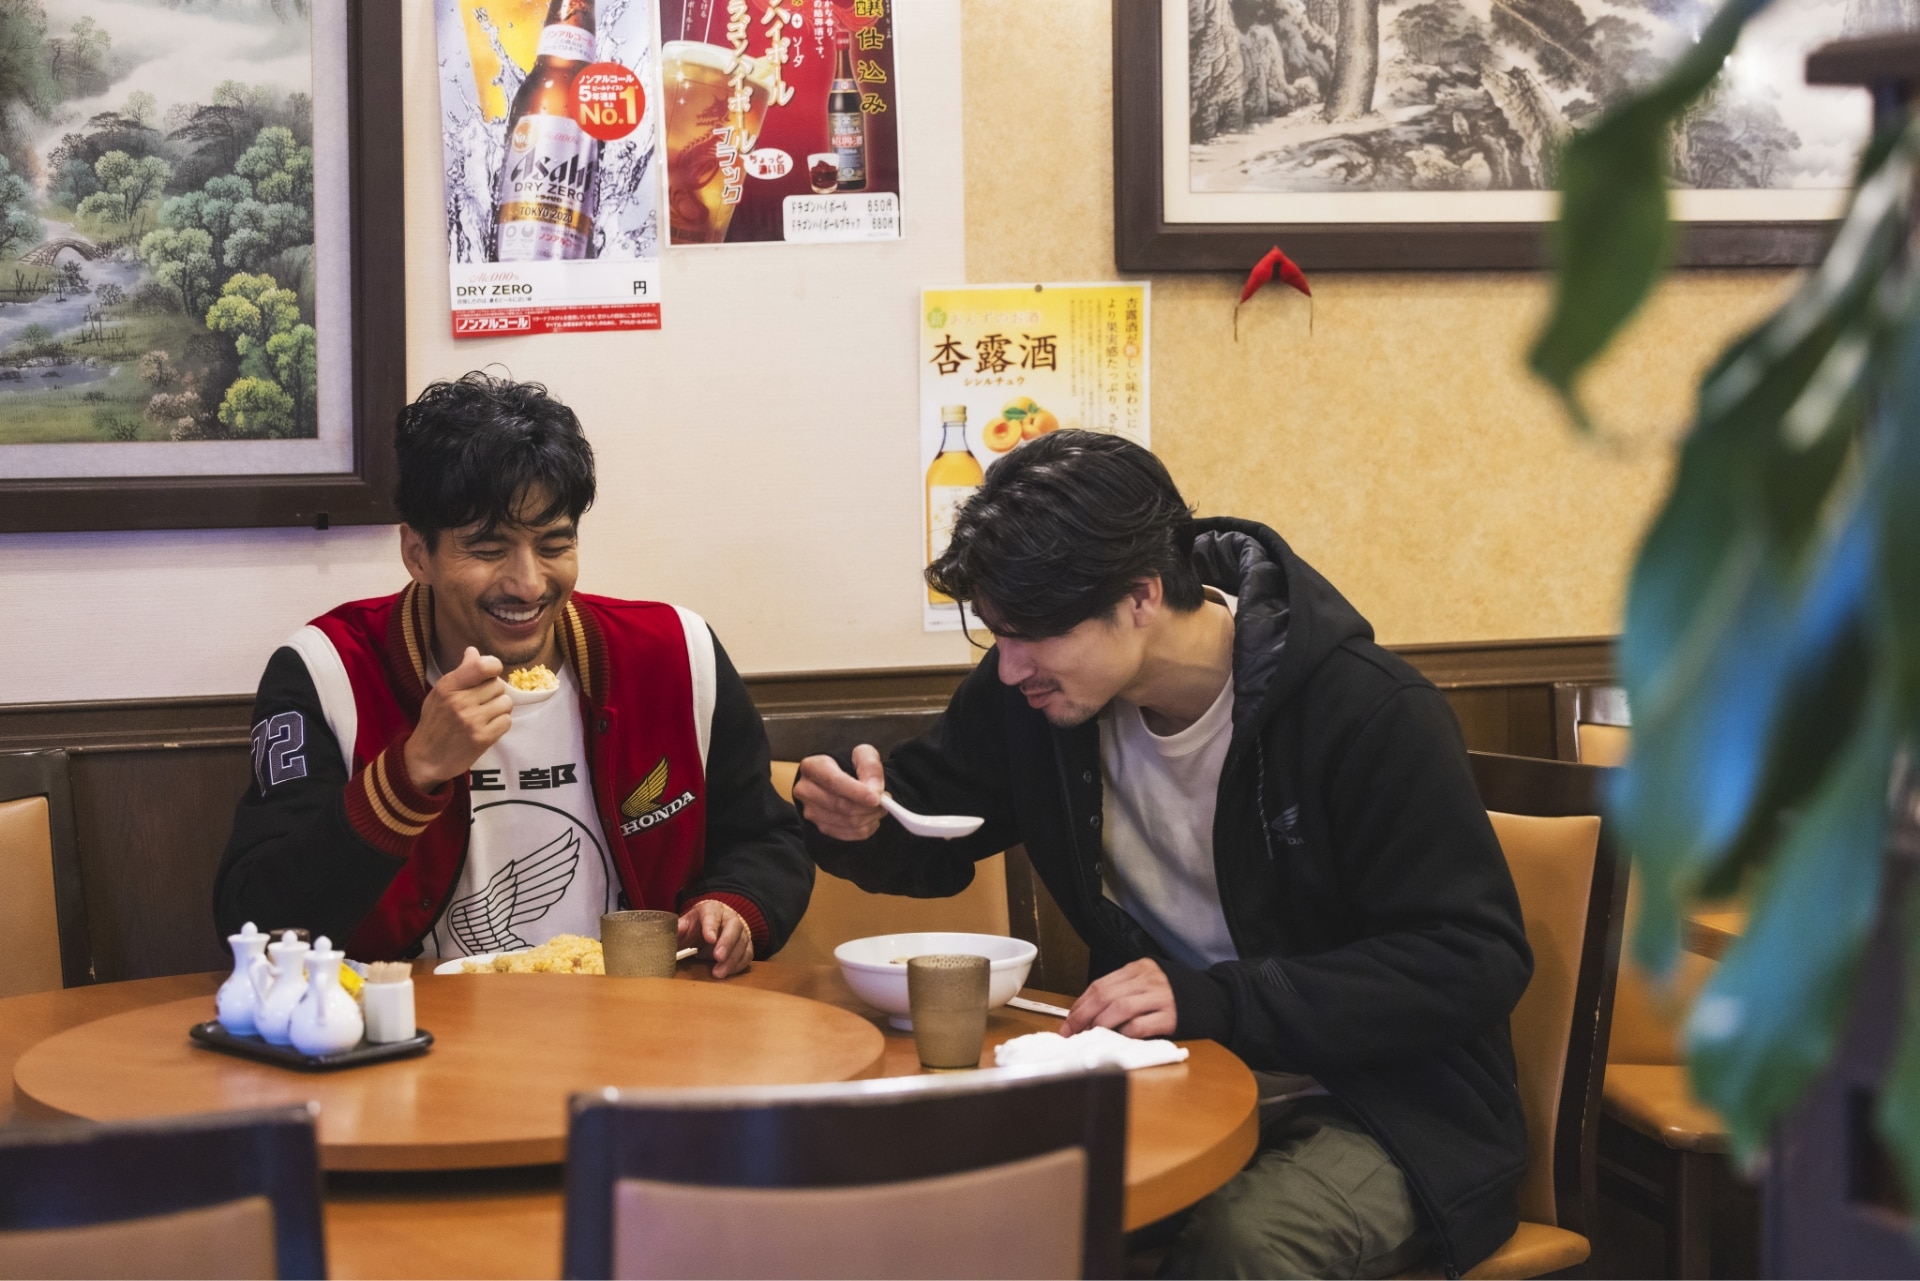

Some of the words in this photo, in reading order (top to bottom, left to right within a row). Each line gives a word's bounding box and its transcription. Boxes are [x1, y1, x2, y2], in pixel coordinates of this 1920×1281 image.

[792, 36, 805, 68] ソーダ
[579, 74, 634, 84] ノンアルコール
[579, 86, 638, 126] No.1
[750, 154, 785, 164] ちょっと
[510, 152, 594, 193] Asahi
[758, 164, 786, 175] 濃い目
[514, 181, 543, 193] DRY
[547, 183, 585, 204] ZERO
[520, 206, 549, 218] TOKYO
[551, 210, 573, 224] 2020
[456, 285, 488, 297] DRY
[492, 284, 533, 296] ZERO
[633, 280, 647, 296] 円
[458, 316, 529, 331] ノンアルコール
[929, 333, 1057, 376] 杏露酒
[964, 376, 1025, 387] シンルチュウ
[251, 711, 307, 797] 72
[620, 791, 696, 836] HONDA
